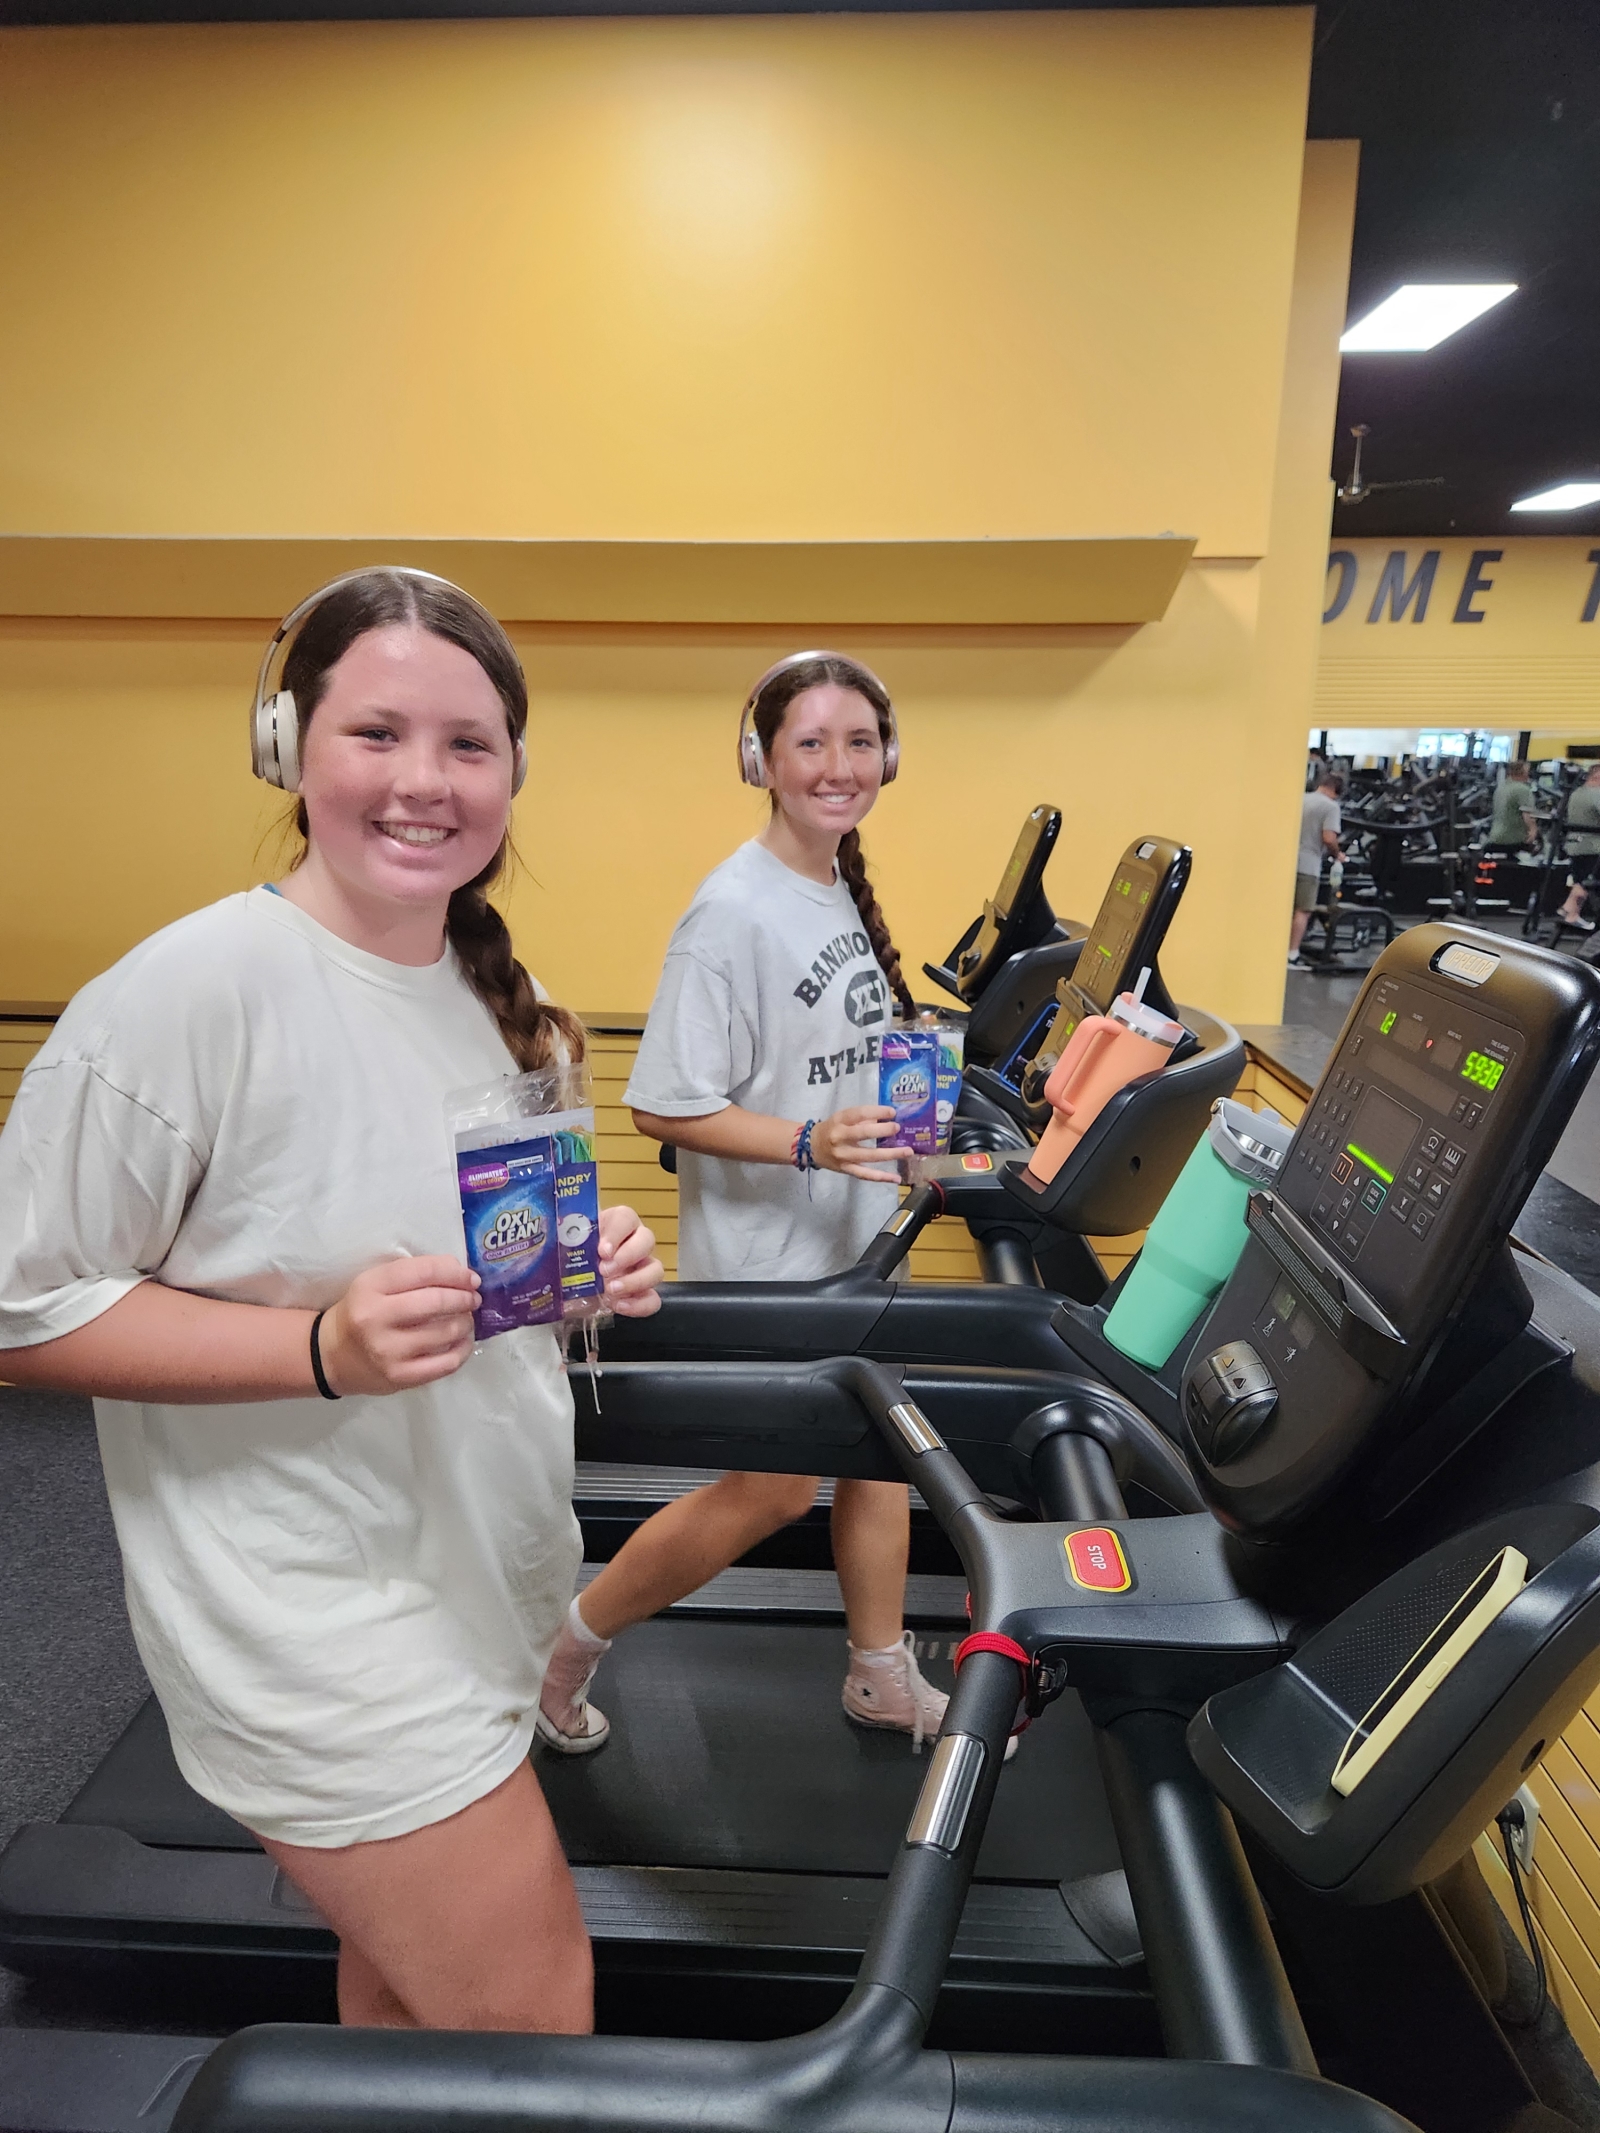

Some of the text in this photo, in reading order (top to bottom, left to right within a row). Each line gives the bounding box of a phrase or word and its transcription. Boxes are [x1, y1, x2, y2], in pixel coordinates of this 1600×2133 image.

[1322, 550, 1503, 624] OME
[892, 1082, 925, 1095] CLEAN
[900, 1074, 920, 1084] OXI
[557, 1172, 592, 1188] NDRY
[495, 1208, 530, 1232] OXI
[484, 1218, 541, 1250] CLEAN
[1087, 1545, 1107, 1570] STOP
